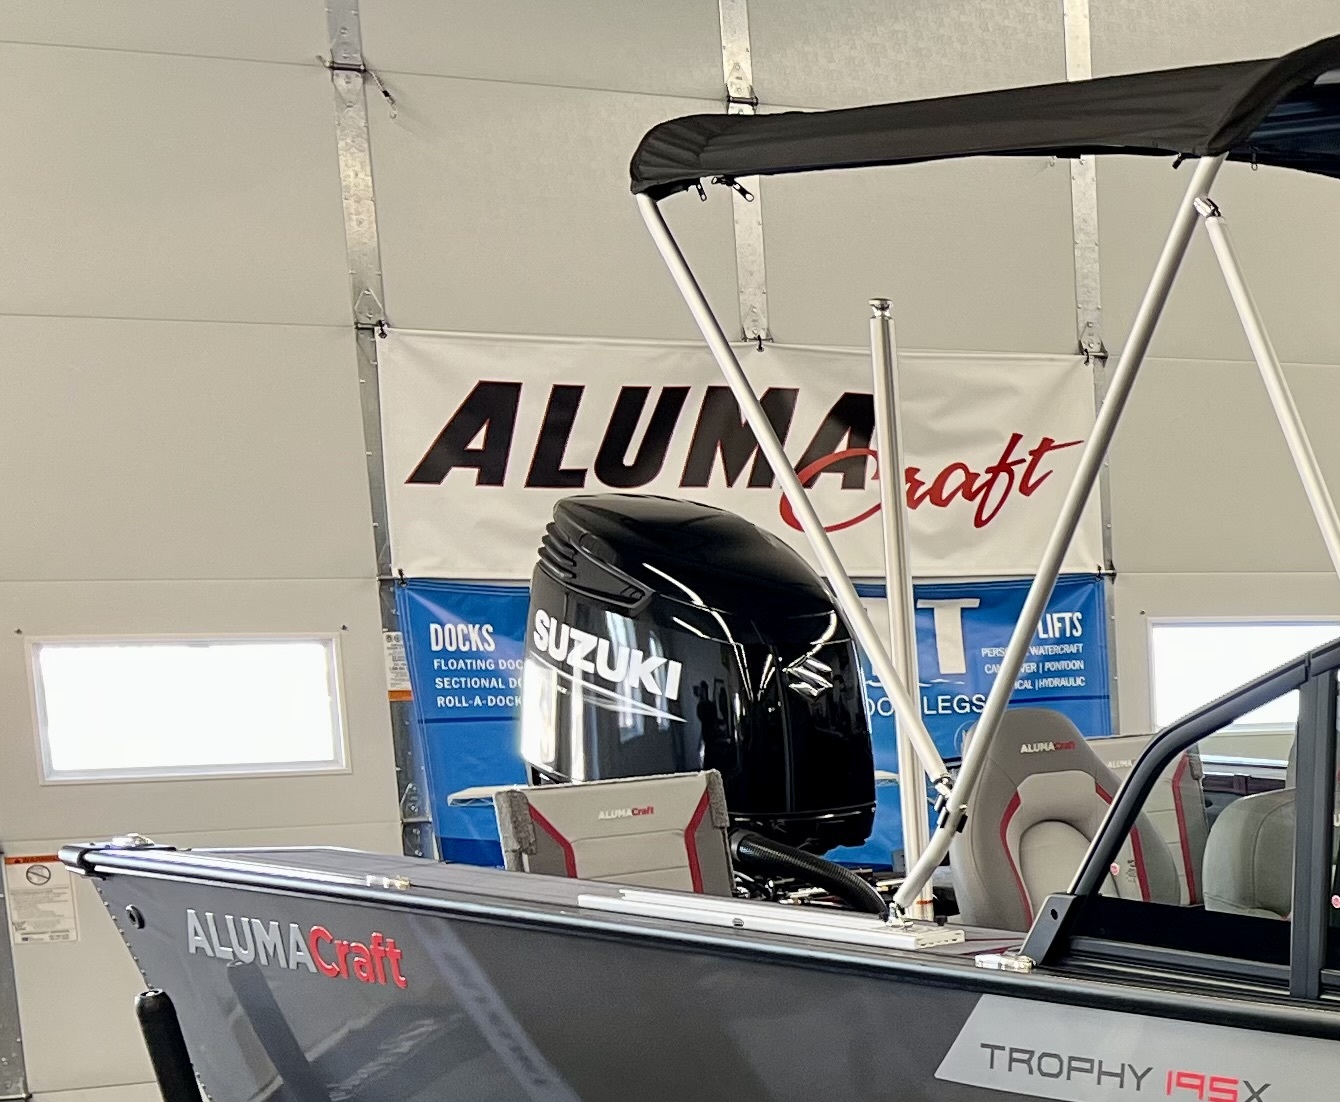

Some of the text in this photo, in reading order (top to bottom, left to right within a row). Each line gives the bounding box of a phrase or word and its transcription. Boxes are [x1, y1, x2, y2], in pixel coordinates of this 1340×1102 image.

[1037, 611, 1083, 638] LIFTS
[429, 623, 496, 652] DOCKS
[533, 609, 683, 703] SUZUKI
[1029, 643, 1083, 656] WATERCRAFT
[433, 658, 495, 670] FLOATING
[1044, 660, 1084, 672] PONTOON
[435, 677, 505, 689] SECTIONAL
[1039, 676, 1086, 688] HYDRAULIC
[922, 694, 986, 715] LEGS
[598, 805, 655, 820] ALUMACraft
[186, 908, 408, 990] ALUMACraft
[980, 1041, 1153, 1091] TROPHY
